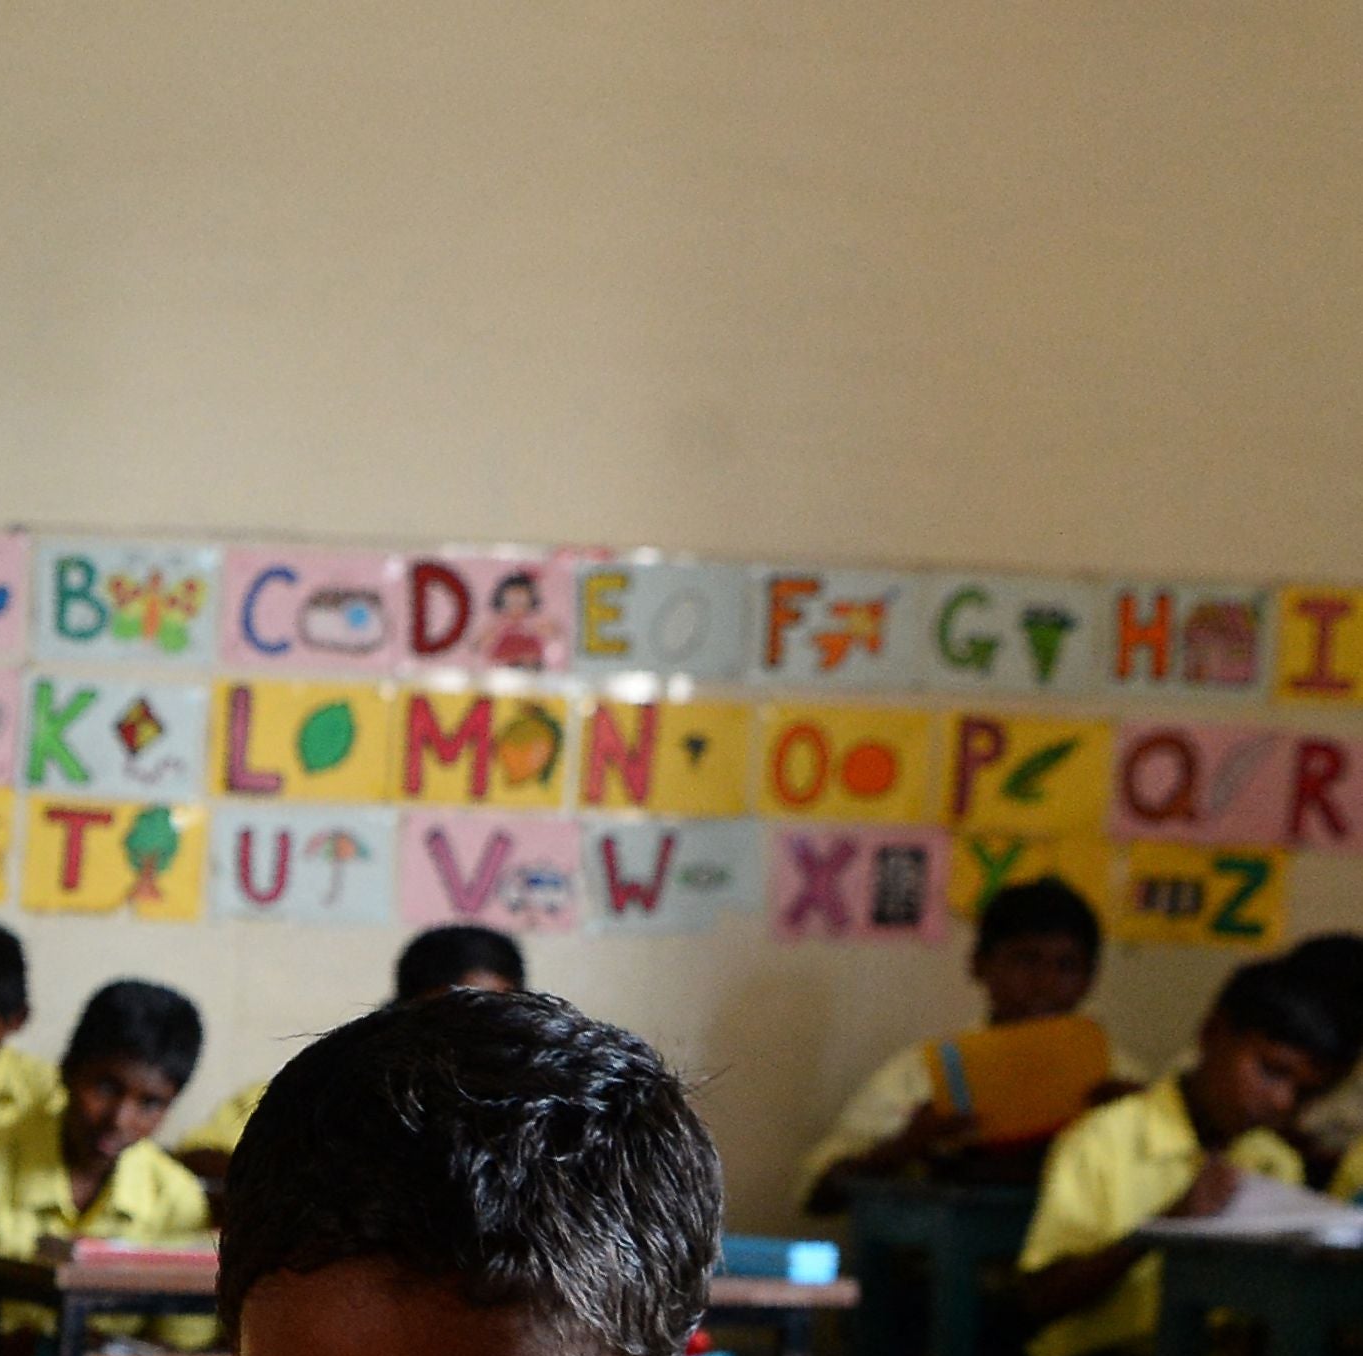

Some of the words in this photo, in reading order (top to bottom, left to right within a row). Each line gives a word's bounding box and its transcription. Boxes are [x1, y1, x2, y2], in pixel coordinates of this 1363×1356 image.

[52, 555, 109, 640] B
[242, 565, 297, 655] C
[408, 560, 471, 656] D
[582, 571, 630, 657] E
[764, 577, 821, 669] F
[936, 581, 999, 671] G
[1116, 589, 1173, 682] H
[1287, 598, 1355, 692] I
[25, 677, 99, 787] K
[224, 684, 284, 796] L
[403, 693, 494, 800] M
[584, 699, 661, 808] N
[773, 721, 831, 809] O
[950, 714, 1009, 823] P
[1123, 728, 1201, 823] Q
[1284, 737, 1348, 843] R
[46, 807, 114, 892] T
[238, 829, 292, 905] U
[422, 825, 512, 916] V
[599, 833, 677, 914] W
[783, 833, 857, 936] X
[969, 837, 1025, 905] Y
[1208, 855, 1271, 936] Z
